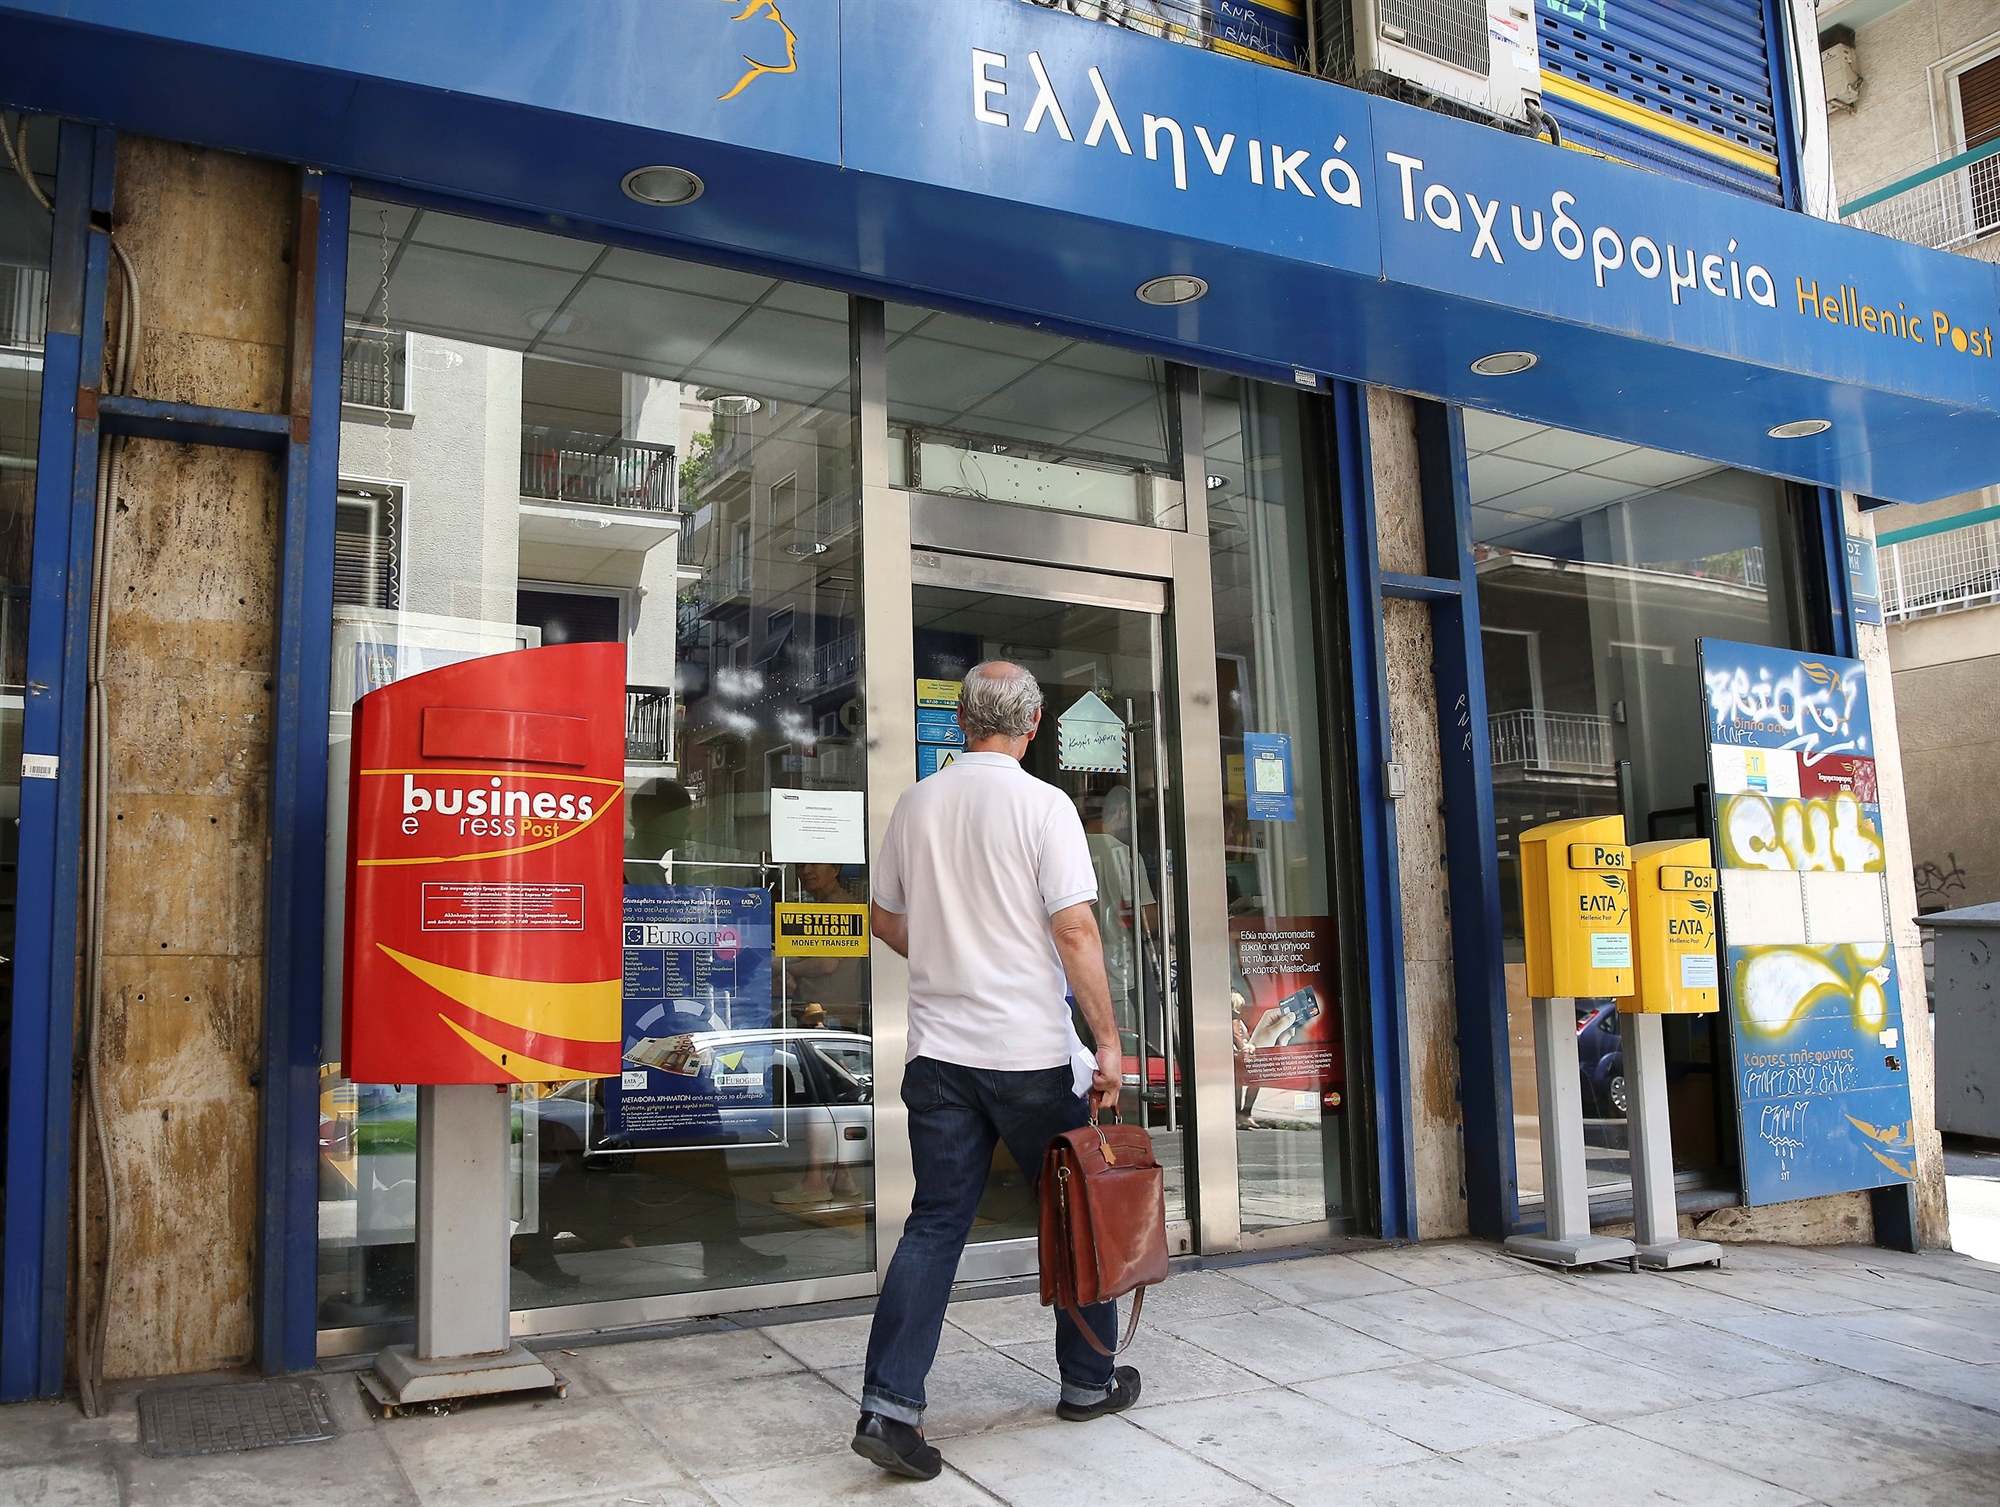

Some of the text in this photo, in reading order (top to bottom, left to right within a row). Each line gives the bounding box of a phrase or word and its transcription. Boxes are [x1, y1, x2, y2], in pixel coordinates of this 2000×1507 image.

[972, 47, 1777, 308] Ελληνικά Ταχυδρομεία
[1795, 276, 1993, 358] Hellenic Post
[402, 774, 595, 821] business
[520, 819, 560, 838] Post
[1594, 847, 1625, 867] Post
[1684, 870, 1712, 889] Post
[1579, 895, 1616, 911] ΕΛΤΑ
[622, 907, 633, 916] για
[622, 915, 635, 923] από
[782, 914, 850, 925] WESTERN
[803, 924, 850, 936] UNION
[1669, 919, 1704, 935] ΕΛΤΑ
[646, 925, 736, 945] EUROGIRO
[1240, 930, 1316, 941] Εδώ πραγματοποιείτε
[791, 939, 859, 947] MONEY TRANSFER
[1241, 942, 1310, 952] εύκολα και γρήγορα
[1241, 953, 1304, 964] τις πληρωμές σας
[1241, 967, 1251, 976] με
[1252, 965, 1279, 976] κάρτες
[1743, 1048, 1854, 1068] Κάρτες τηλεφωνίας
[657, 1094, 691, 1102] ΧΡΗΜΑΤΩΝ
[714, 1094, 728, 1102] προς
